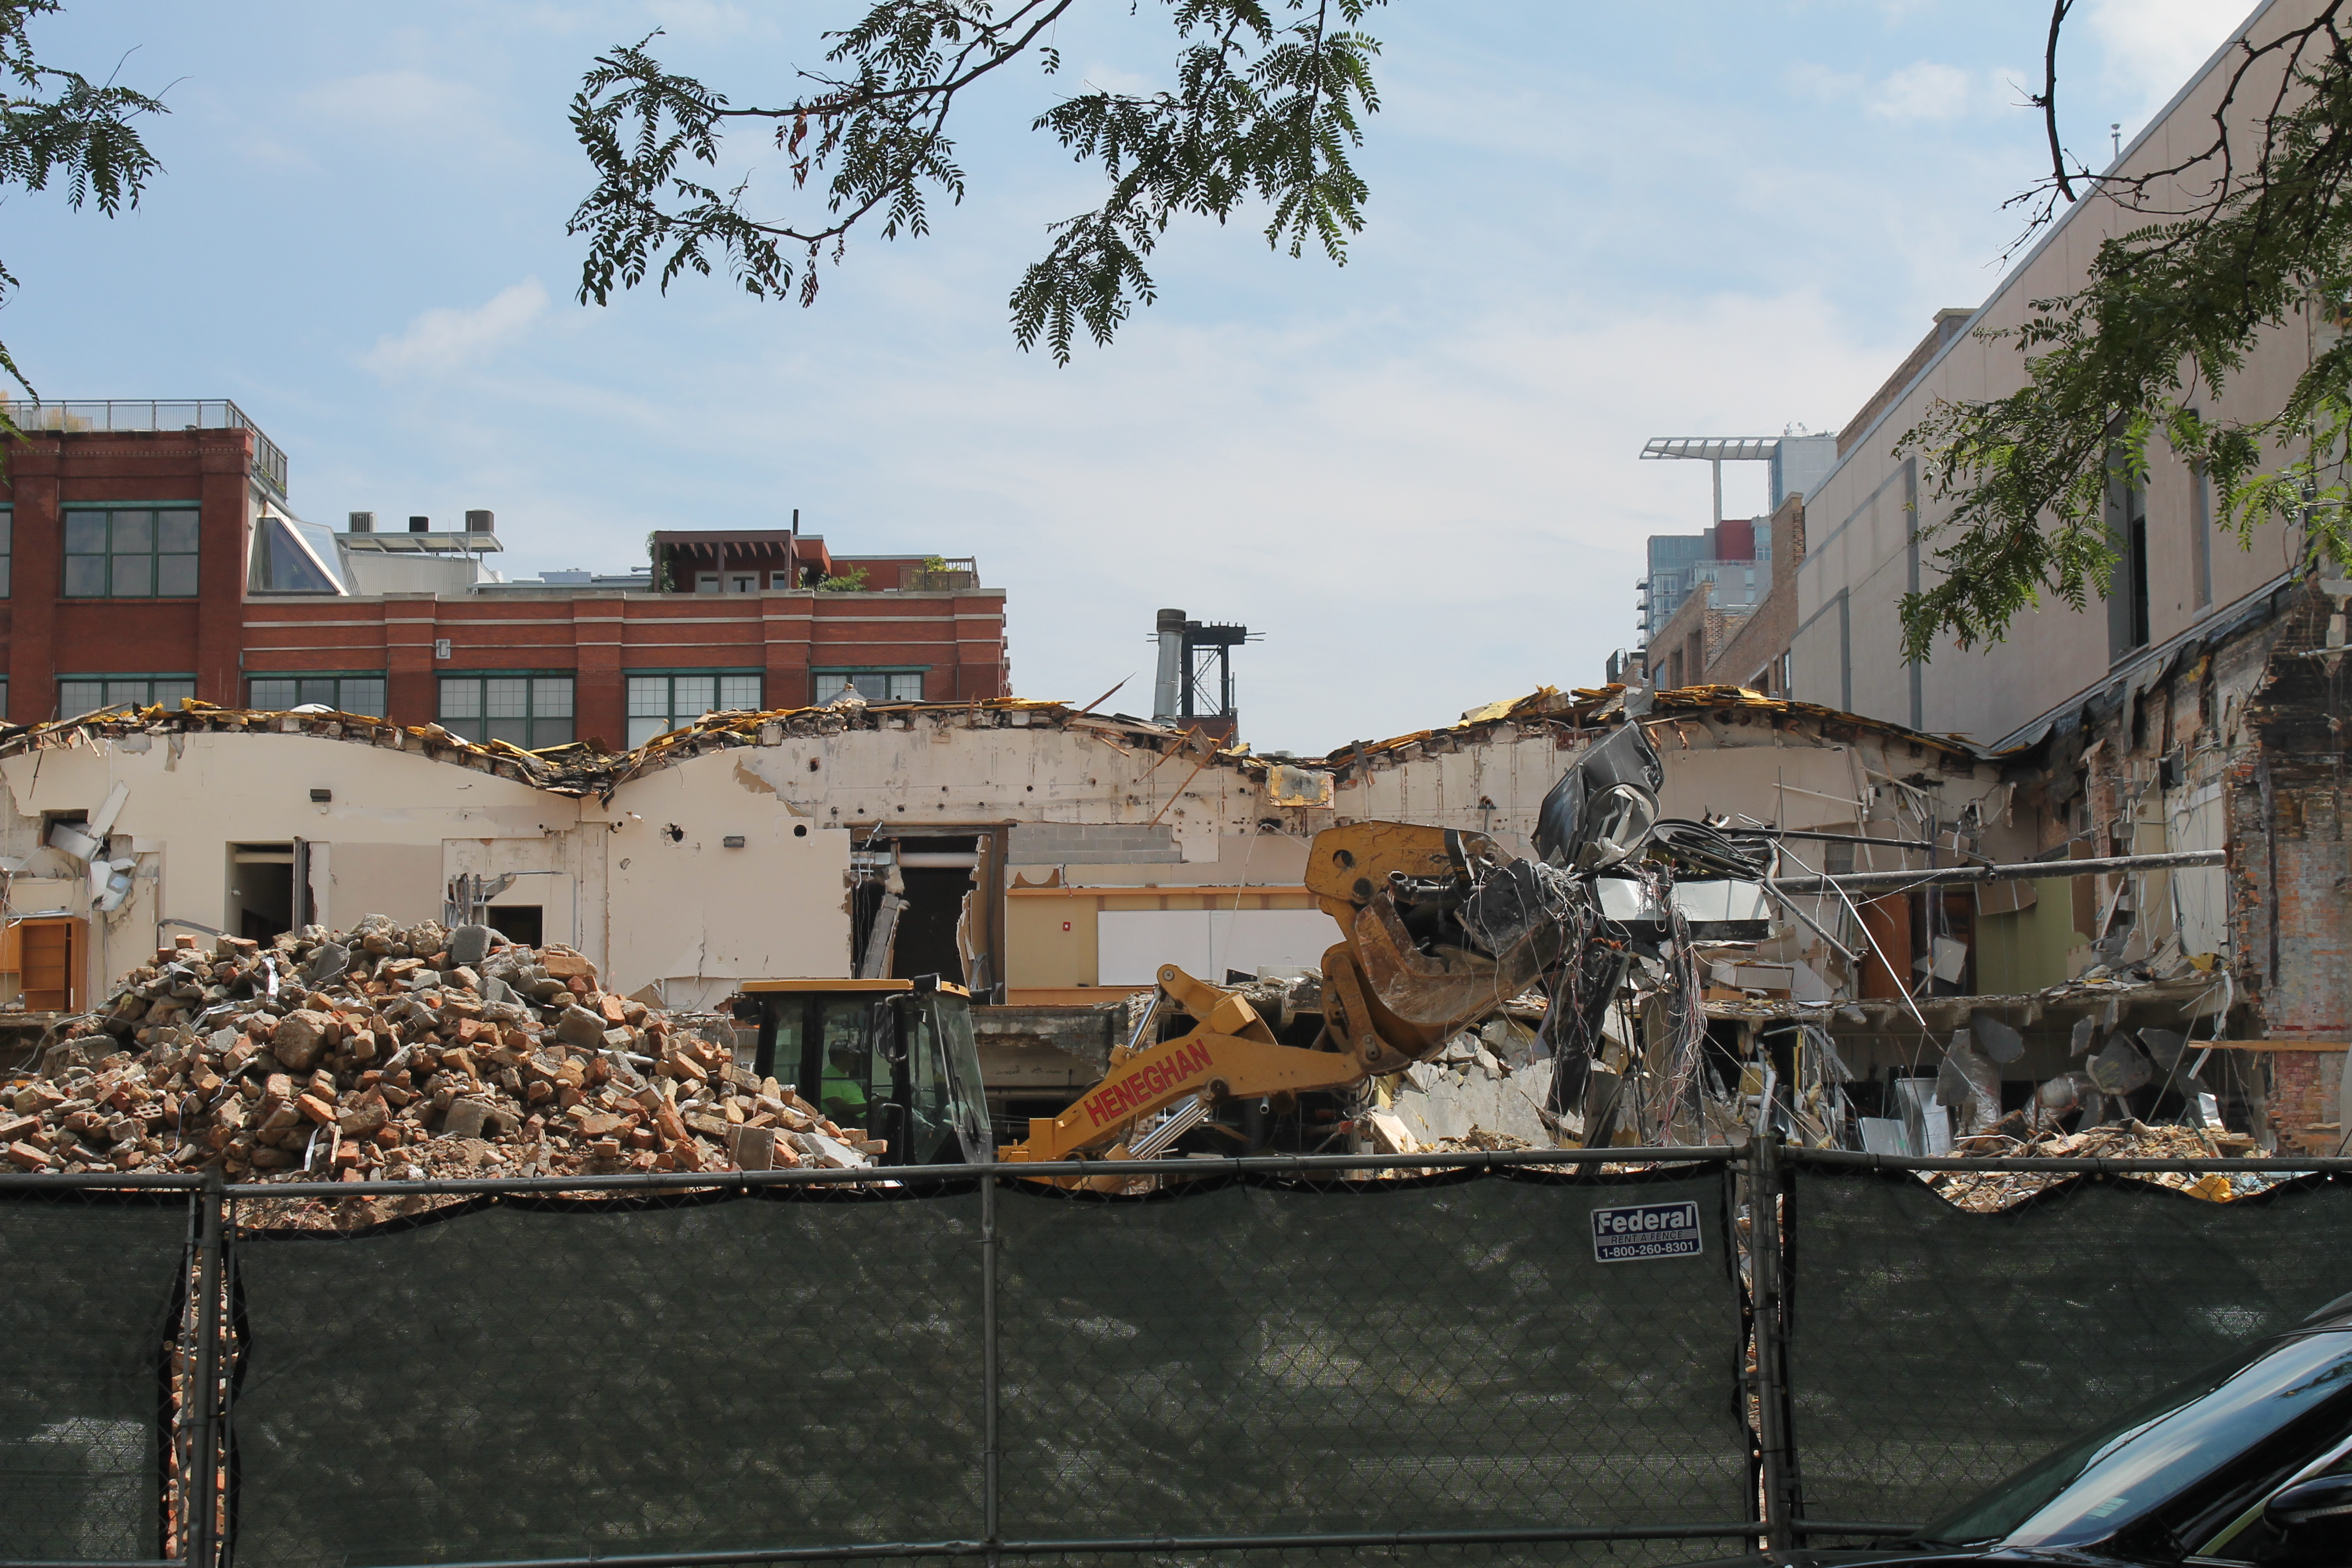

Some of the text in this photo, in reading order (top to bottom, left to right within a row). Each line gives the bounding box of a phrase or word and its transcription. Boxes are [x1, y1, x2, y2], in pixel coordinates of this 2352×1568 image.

[1083, 1038, 1213, 1127] HENEGHAN
[1598, 1206, 1692, 1234] Federal
[1611, 1231, 1683, 1244] RENT A FENCE
[1603, 1241, 1693, 1257] 1-800-260-8301
